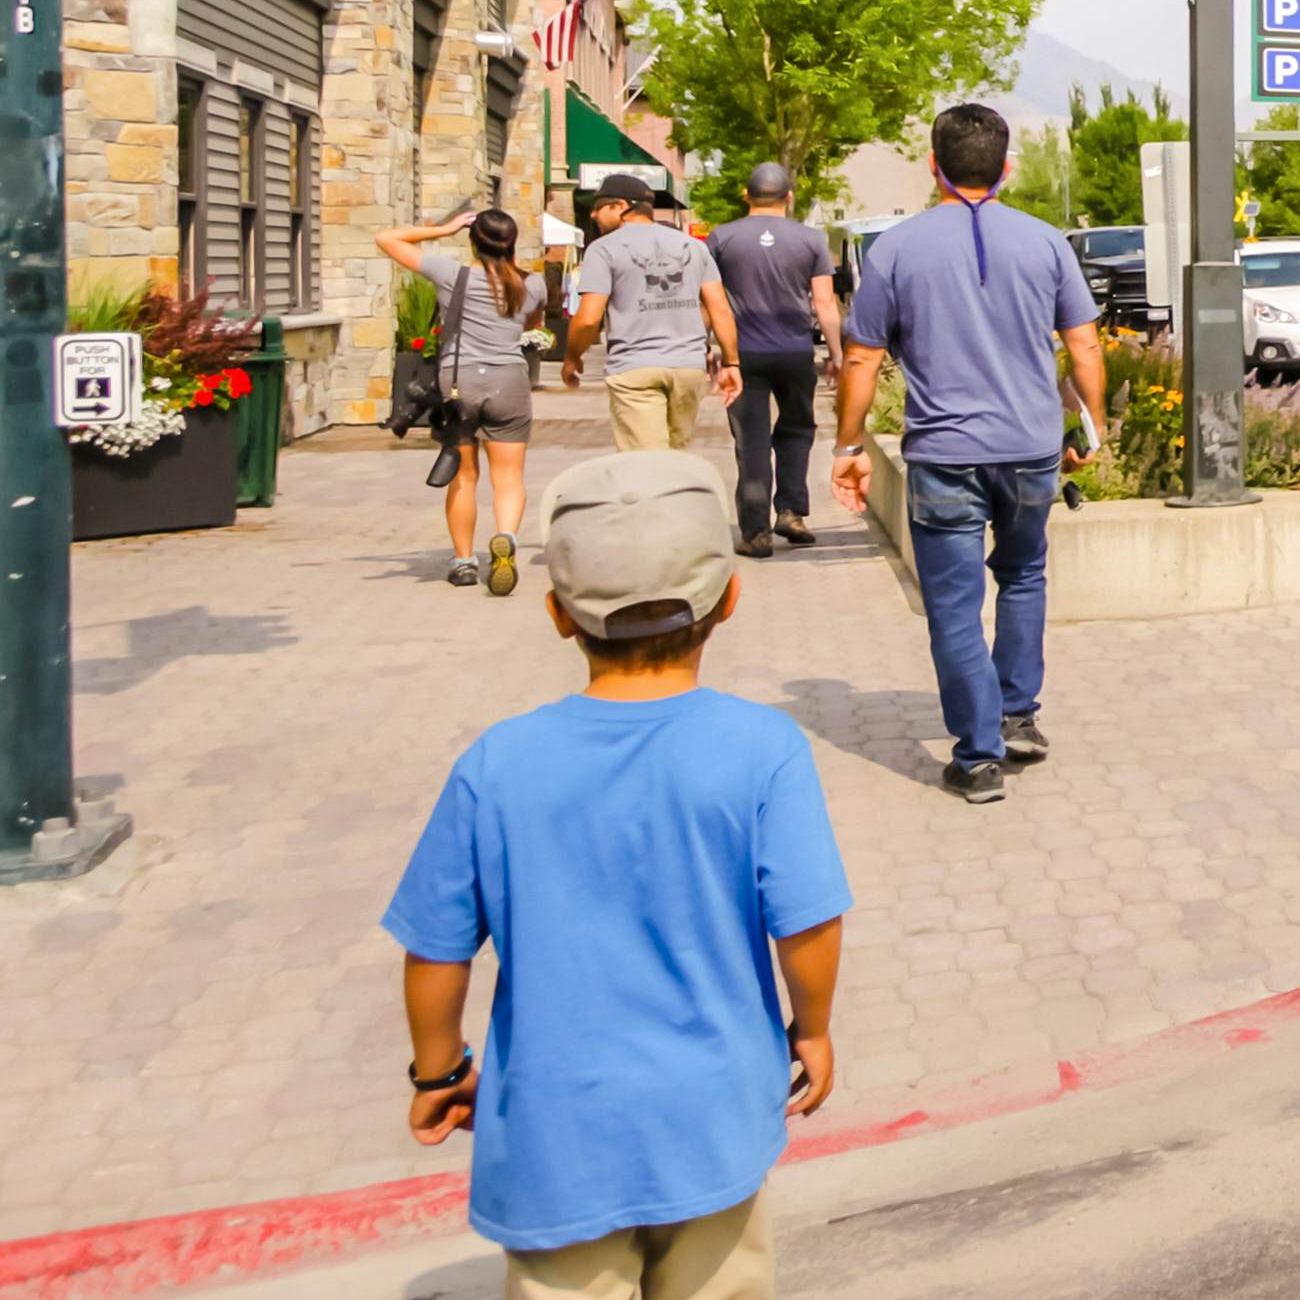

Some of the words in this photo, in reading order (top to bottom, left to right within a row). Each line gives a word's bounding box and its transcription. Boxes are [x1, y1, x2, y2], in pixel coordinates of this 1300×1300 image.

[1274, 54, 1299, 85] P
[75, 345, 110, 354] PUSH
[65, 356, 119, 365] BUTTON
[80, 366, 106, 375] FOR
